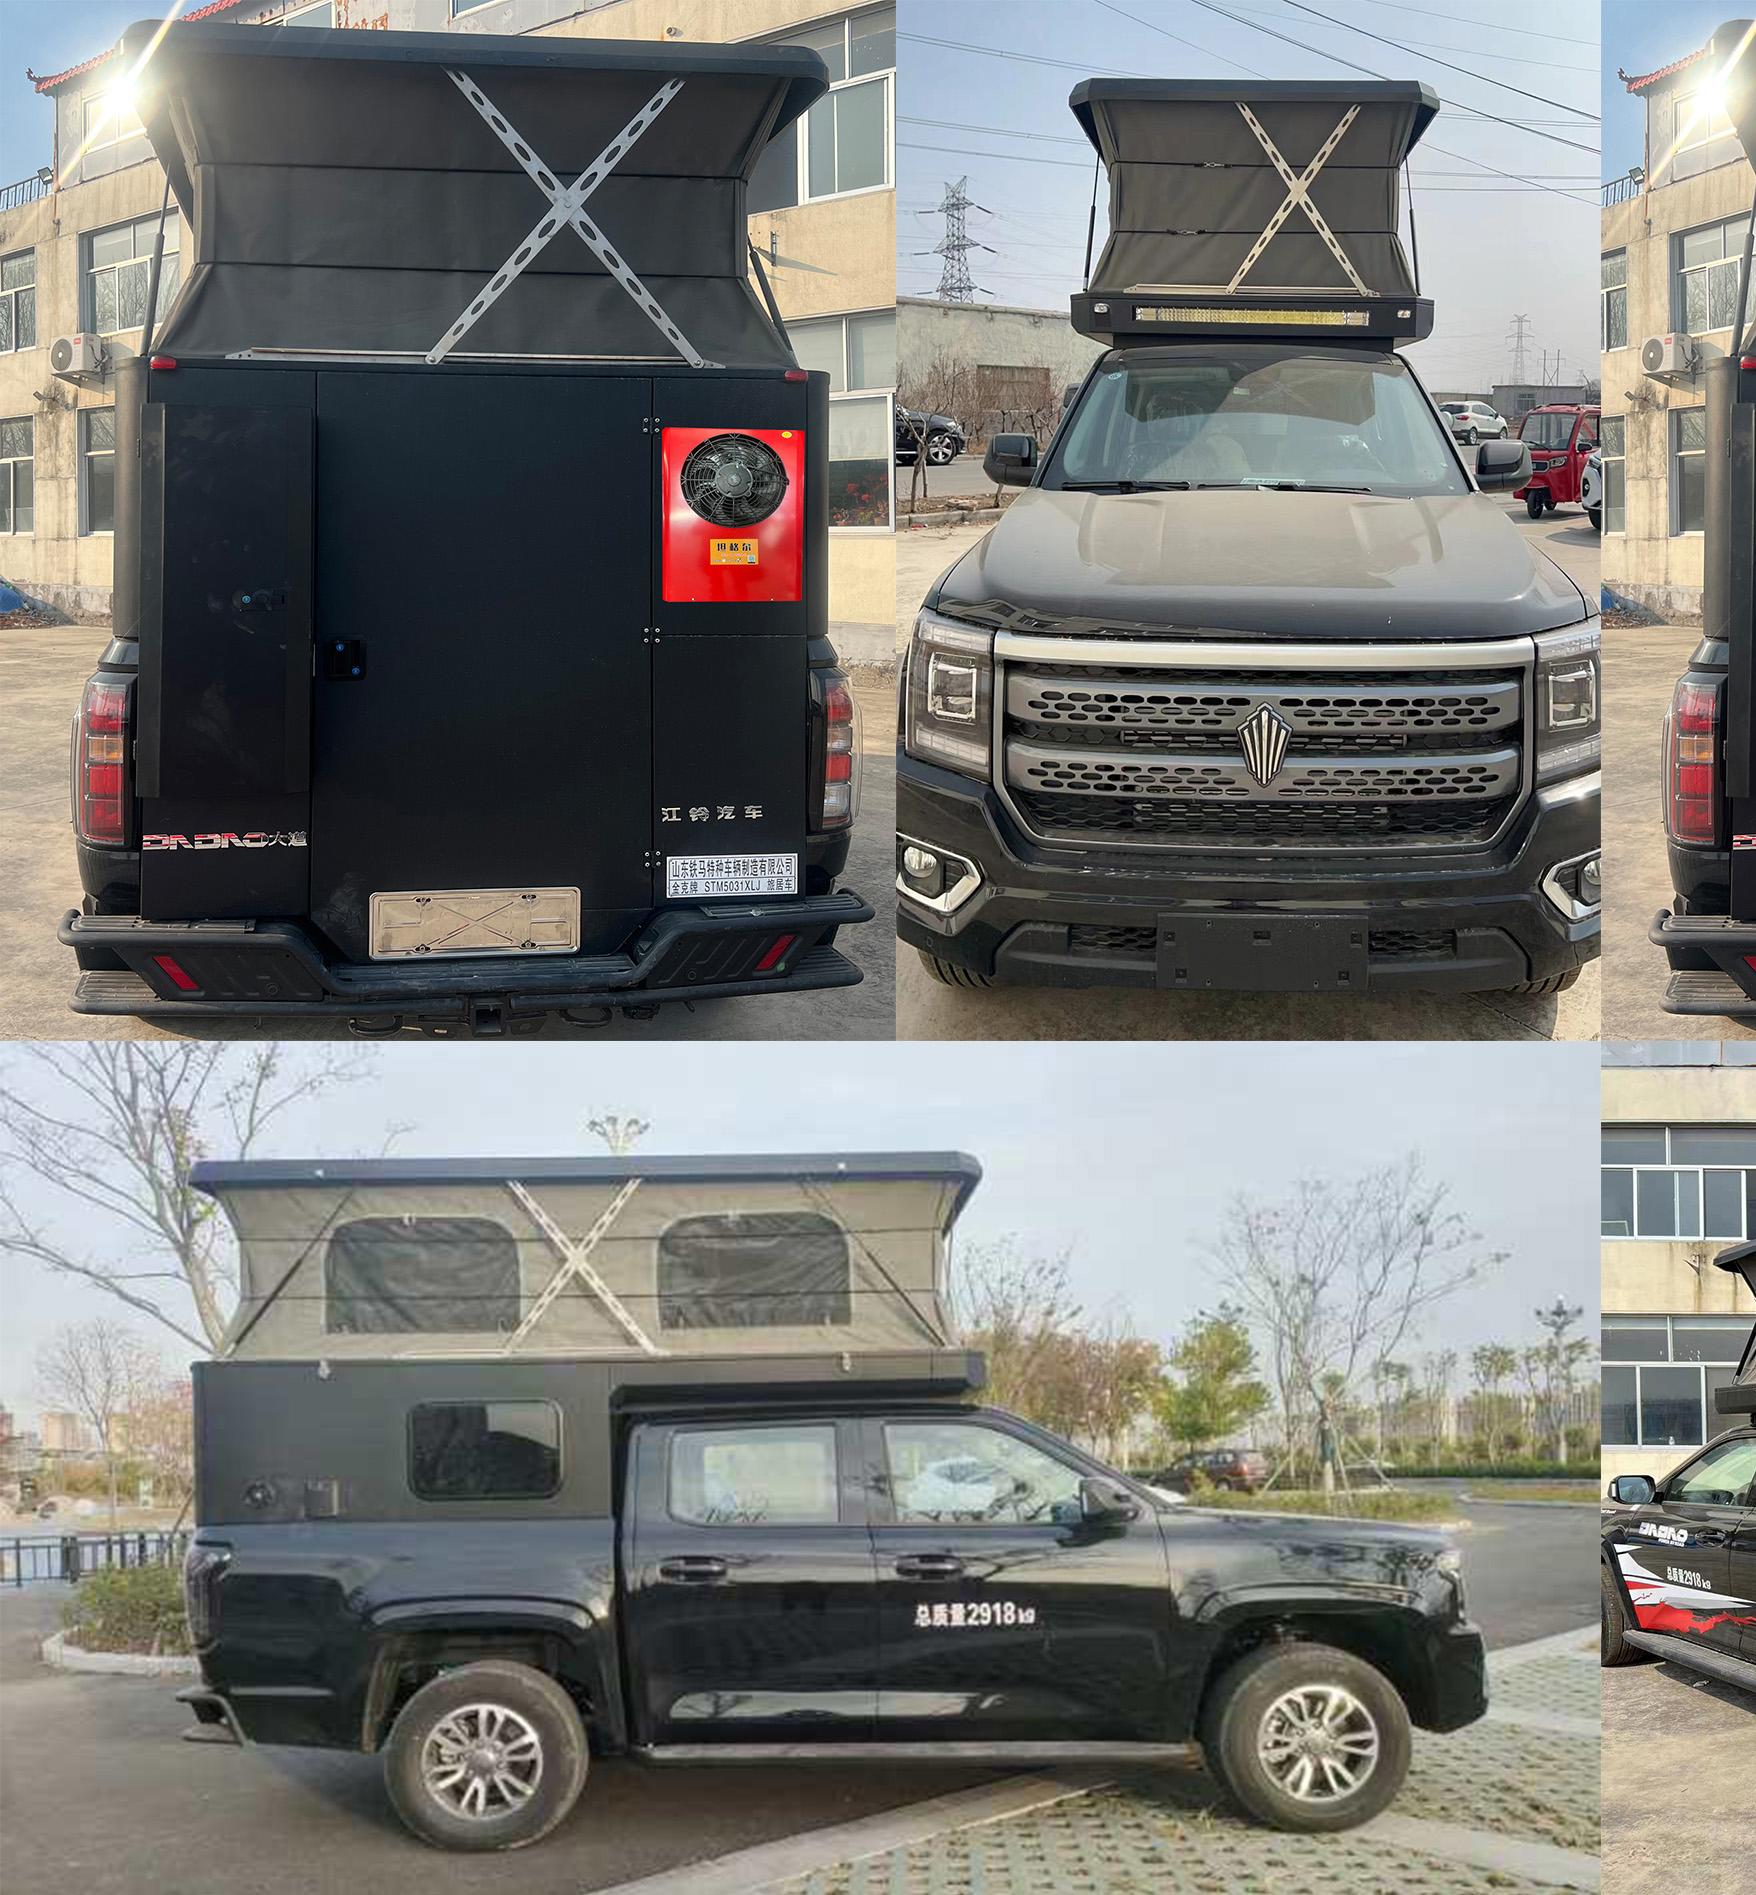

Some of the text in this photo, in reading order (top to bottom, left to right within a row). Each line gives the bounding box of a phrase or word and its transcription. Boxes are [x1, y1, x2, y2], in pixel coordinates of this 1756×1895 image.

[661, 805, 763, 822] 江铃汽车
[704, 881, 761, 893] STM5031XLJ
